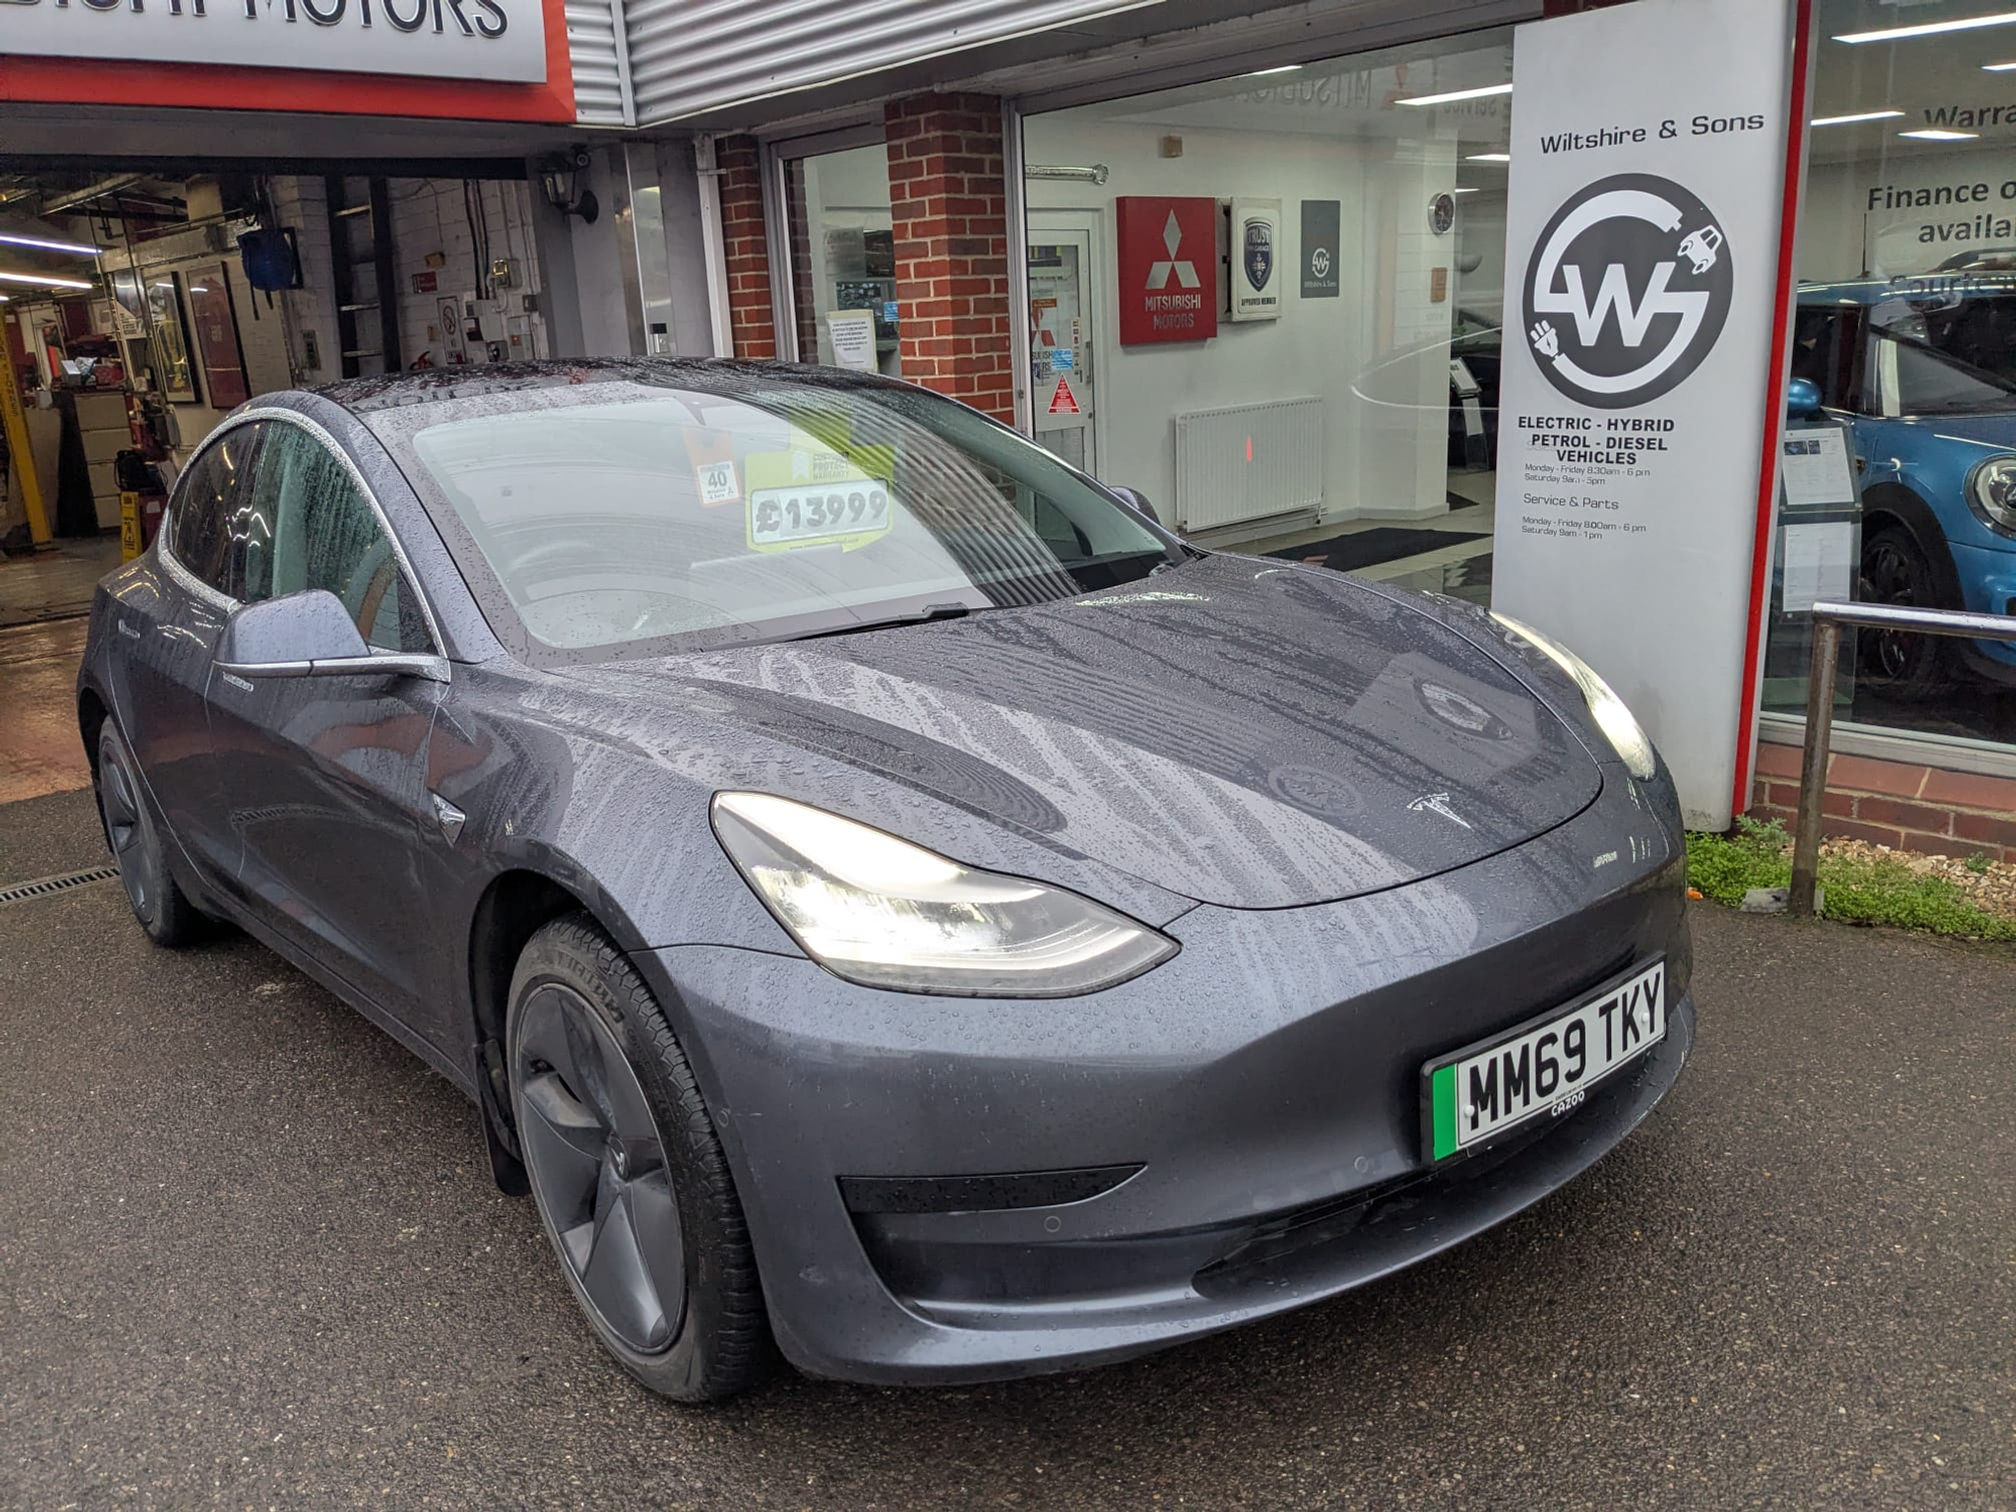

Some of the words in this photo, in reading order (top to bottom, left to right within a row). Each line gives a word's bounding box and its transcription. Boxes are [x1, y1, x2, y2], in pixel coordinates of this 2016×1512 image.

[1540, 126, 1647, 154] Wiltshire
[1658, 119, 1677, 139] &
[1691, 114, 1764, 136] Sons
[1868, 181, 1989, 211] Finance
[1247, 226, 1271, 244] TRUST
[1918, 213, 2016, 243] availa
[1145, 293, 1201, 313] MITSUBISHI
[1153, 312, 1194, 330] MOTORS
[1518, 416, 1592, 430] ELECTRIC
[1607, 418, 1675, 432] HYBRID
[1531, 434, 1591, 448] PETROL
[1606, 437, 1667, 451] DIESEL
[1556, 450, 1637, 465] VEHICLES
[707, 470, 728, 488] 40
[1524, 473, 1560, 484] Saturday
[1525, 463, 1555, 473] Monday
[1560, 465, 1585, 475] Friday
[1627, 467, 1634, 476] 6
[1635, 469, 1651, 477] pm
[1523, 493, 1566, 507] Service
[1569, 496, 1579, 507] &
[1582, 497, 1619, 510] Parts
[756, 489, 887, 534] £13999
[1521, 525, 1557, 537] Saturday
[1559, 528, 1577, 536] 9am
[1584, 531, 1603, 539] 1pm
[1522, 516, 1552, 526] Monday
[1558, 519, 1582, 529] Friday
[1624, 524, 1630, 532] 6
[1631, 525, 1647, 533] pm
[1469, 1018, 1586, 1132] MM69
[1598, 971, 1660, 1063] TKY
[1551, 1090, 1585, 1117] CAZOO
